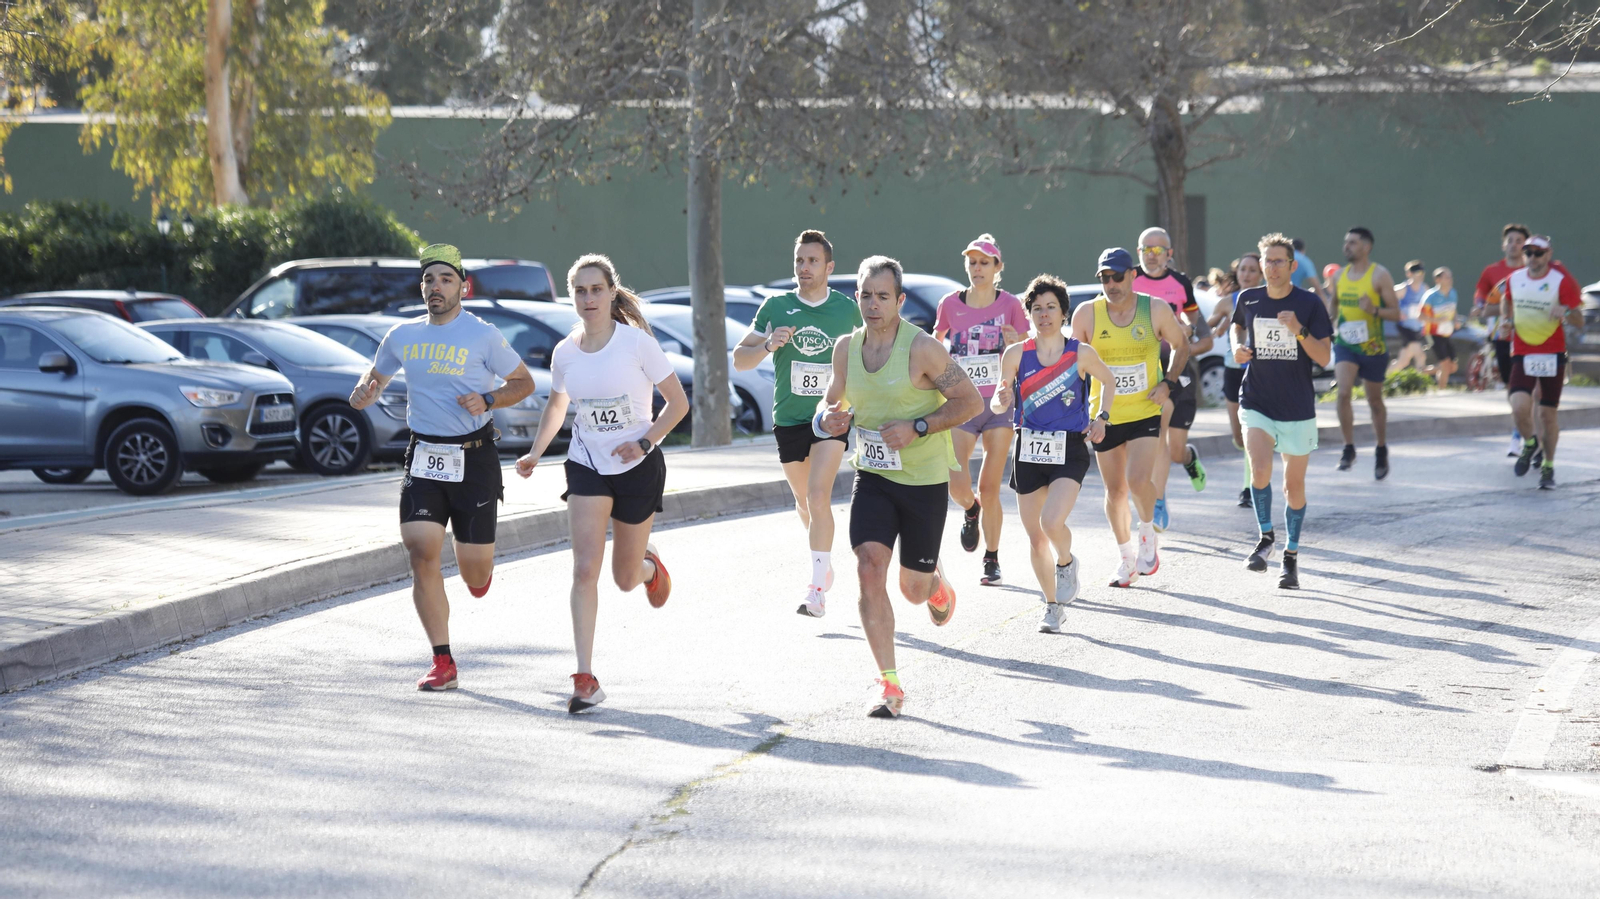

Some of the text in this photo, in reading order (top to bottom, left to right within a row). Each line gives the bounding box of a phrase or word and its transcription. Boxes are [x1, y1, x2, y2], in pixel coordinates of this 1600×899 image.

[797, 335, 835, 346] TOSCAN
[1266, 330, 1281, 342] 45
[403, 343, 469, 366] FATIGAS
[427, 361, 466, 376] Bikes
[967, 366, 989, 379] 249
[802, 375, 818, 388] 83
[1045, 371, 1071, 392] JIMENA
[1115, 376, 1136, 388] 255
[1033, 383, 1067, 408] RUNNERS
[591, 410, 619, 425] 142
[596, 425, 624, 433] EVOS
[864, 442, 885, 460] 205
[1029, 441, 1051, 455] 174
[427, 455, 445, 471] 96
[868, 461, 889, 469] EVOS
[424, 471, 450, 480] EVOS
